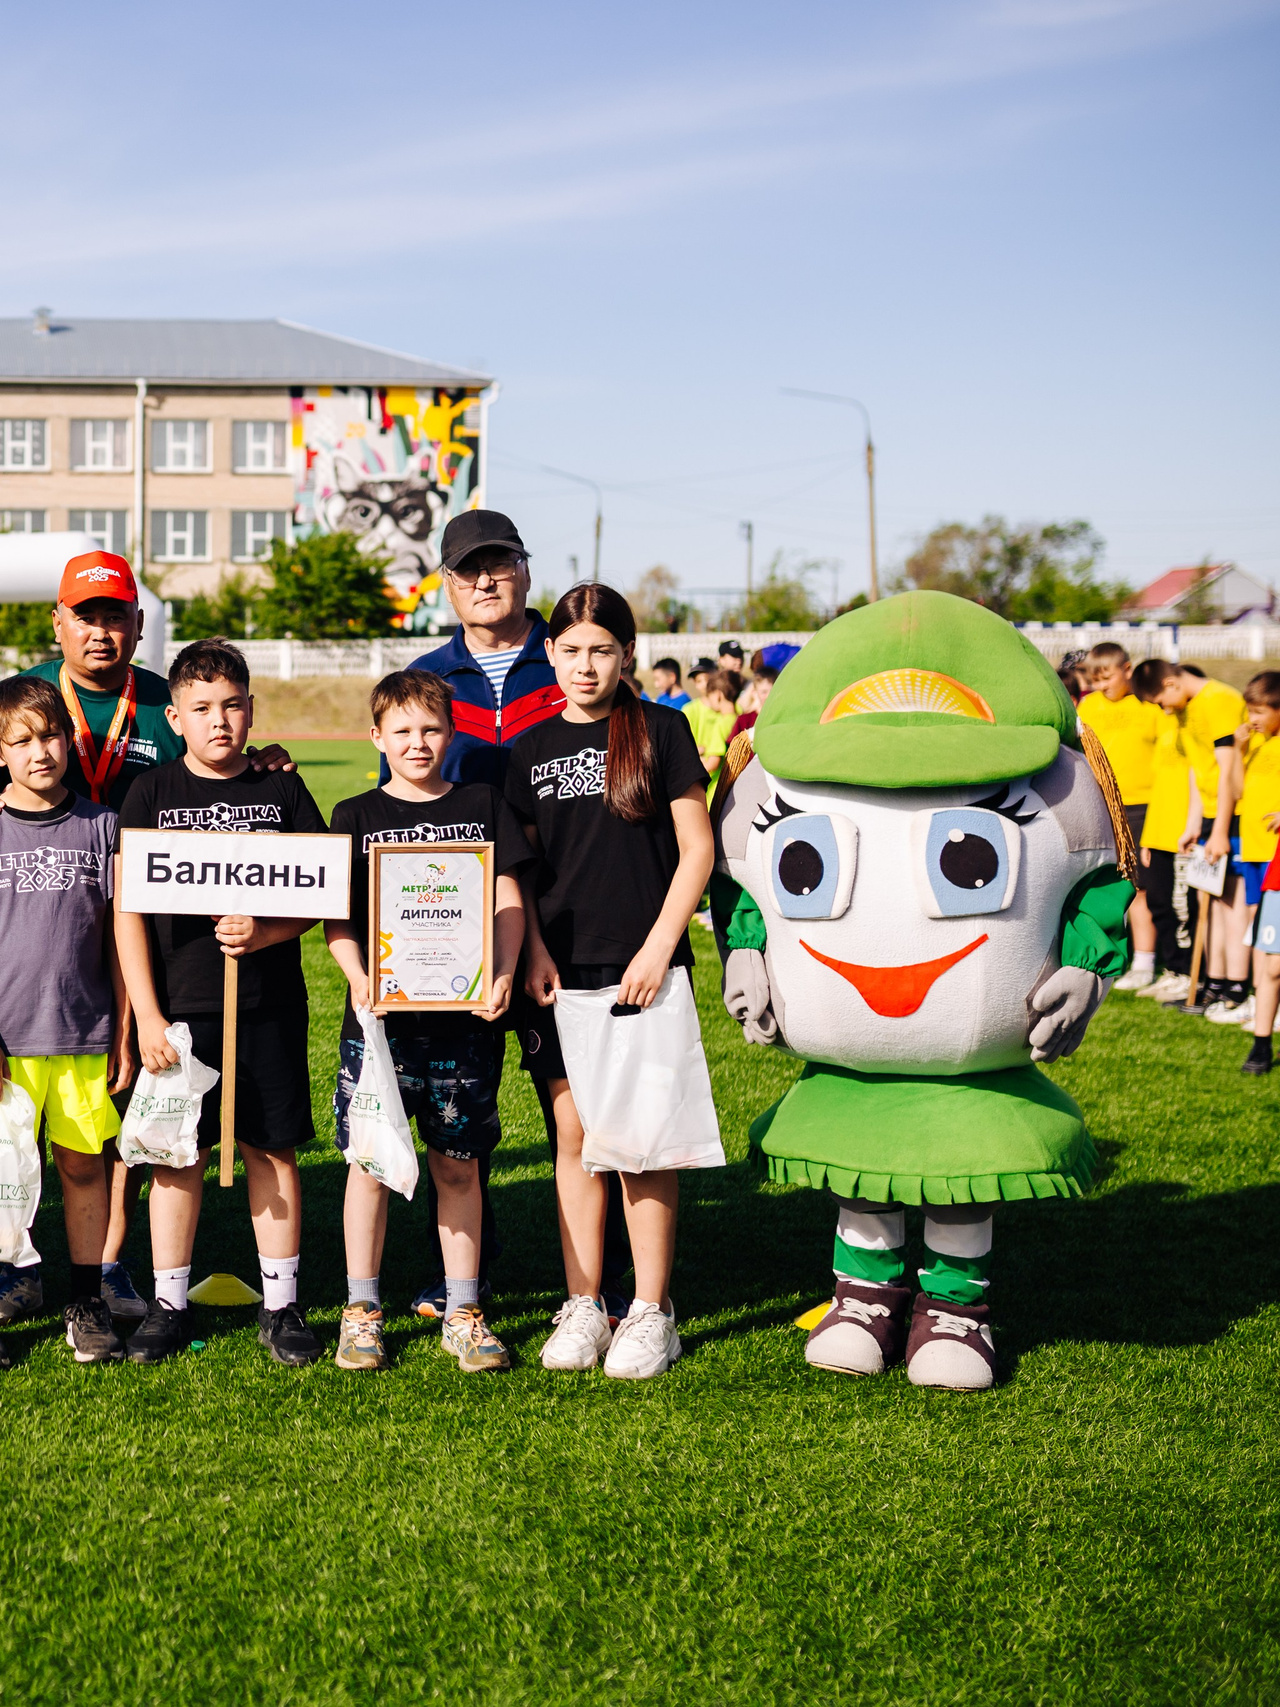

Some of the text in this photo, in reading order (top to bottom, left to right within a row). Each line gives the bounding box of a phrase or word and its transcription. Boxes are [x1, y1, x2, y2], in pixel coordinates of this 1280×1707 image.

[158, 802, 281, 829] МЕТРОШКА
[16, 867, 76, 893] 2025
[146, 852, 326, 888] Балканы
[418, 893, 443, 903] 2025
[400, 910, 462, 920] ДИПЛОМ
